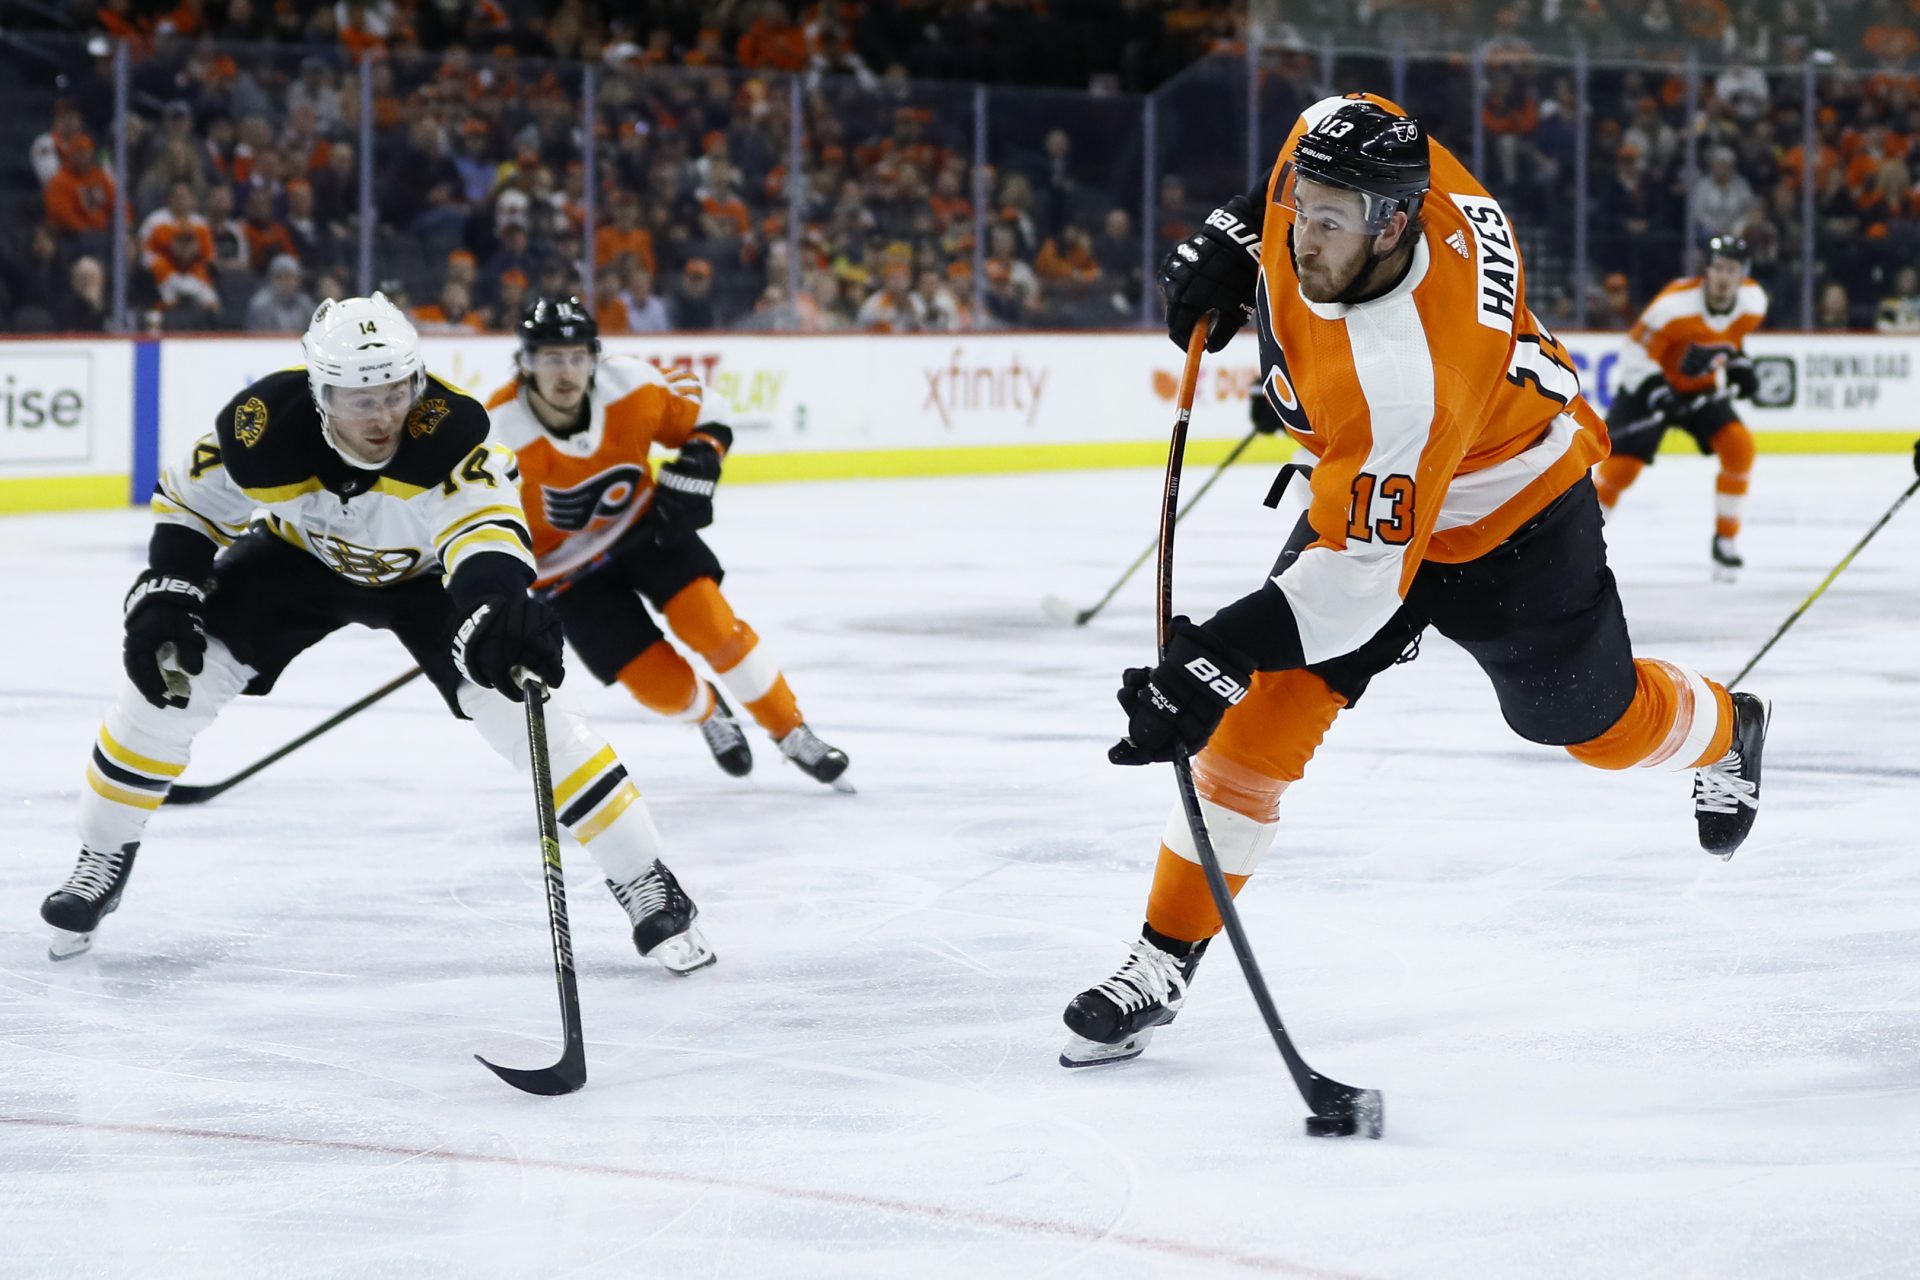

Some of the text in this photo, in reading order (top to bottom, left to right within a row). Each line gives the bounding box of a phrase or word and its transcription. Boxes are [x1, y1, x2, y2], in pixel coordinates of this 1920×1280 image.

[1318, 114, 1355, 139] 13
[1301, 147, 1333, 163] BAUER
[1456, 229, 1470, 259] adidas
[1462, 204, 1518, 322] HAYES
[359, 320, 378, 336] 14
[358, 361, 394, 372] BAUER
[1805, 352, 1911, 379] DOWNLOAD
[0, 374, 83, 430] ise
[922, 346, 1051, 431] xfinity
[1806, 384, 1880, 409] THE APP
[1346, 471, 1416, 546] 13
[1147, 682, 1178, 714] NEXUS
